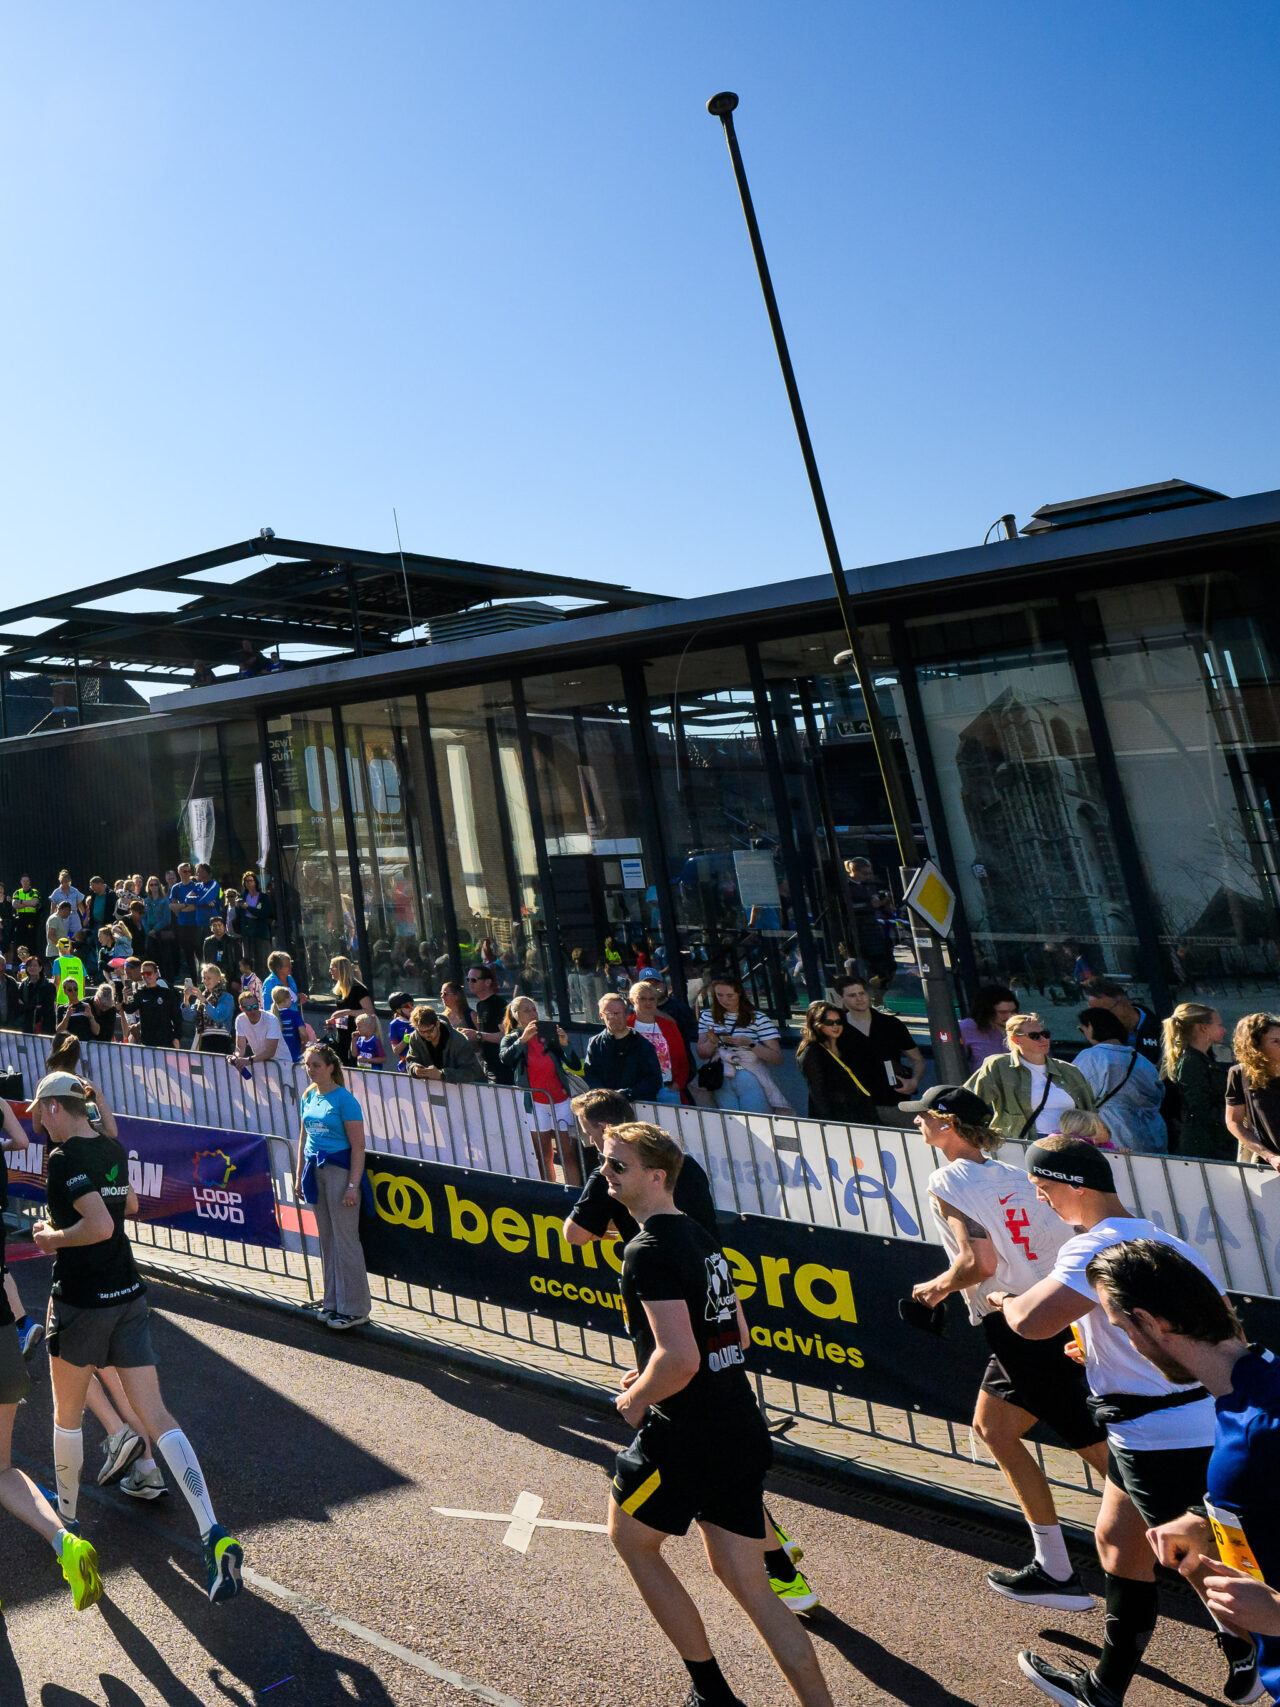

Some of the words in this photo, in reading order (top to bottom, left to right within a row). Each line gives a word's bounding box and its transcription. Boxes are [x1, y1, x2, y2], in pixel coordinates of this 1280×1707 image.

[1033, 1166, 1084, 1184] ROGUE
[192, 1186, 242, 1206] LOOP
[196, 1201, 245, 1225] LWD
[751, 1325, 865, 1369] advies
